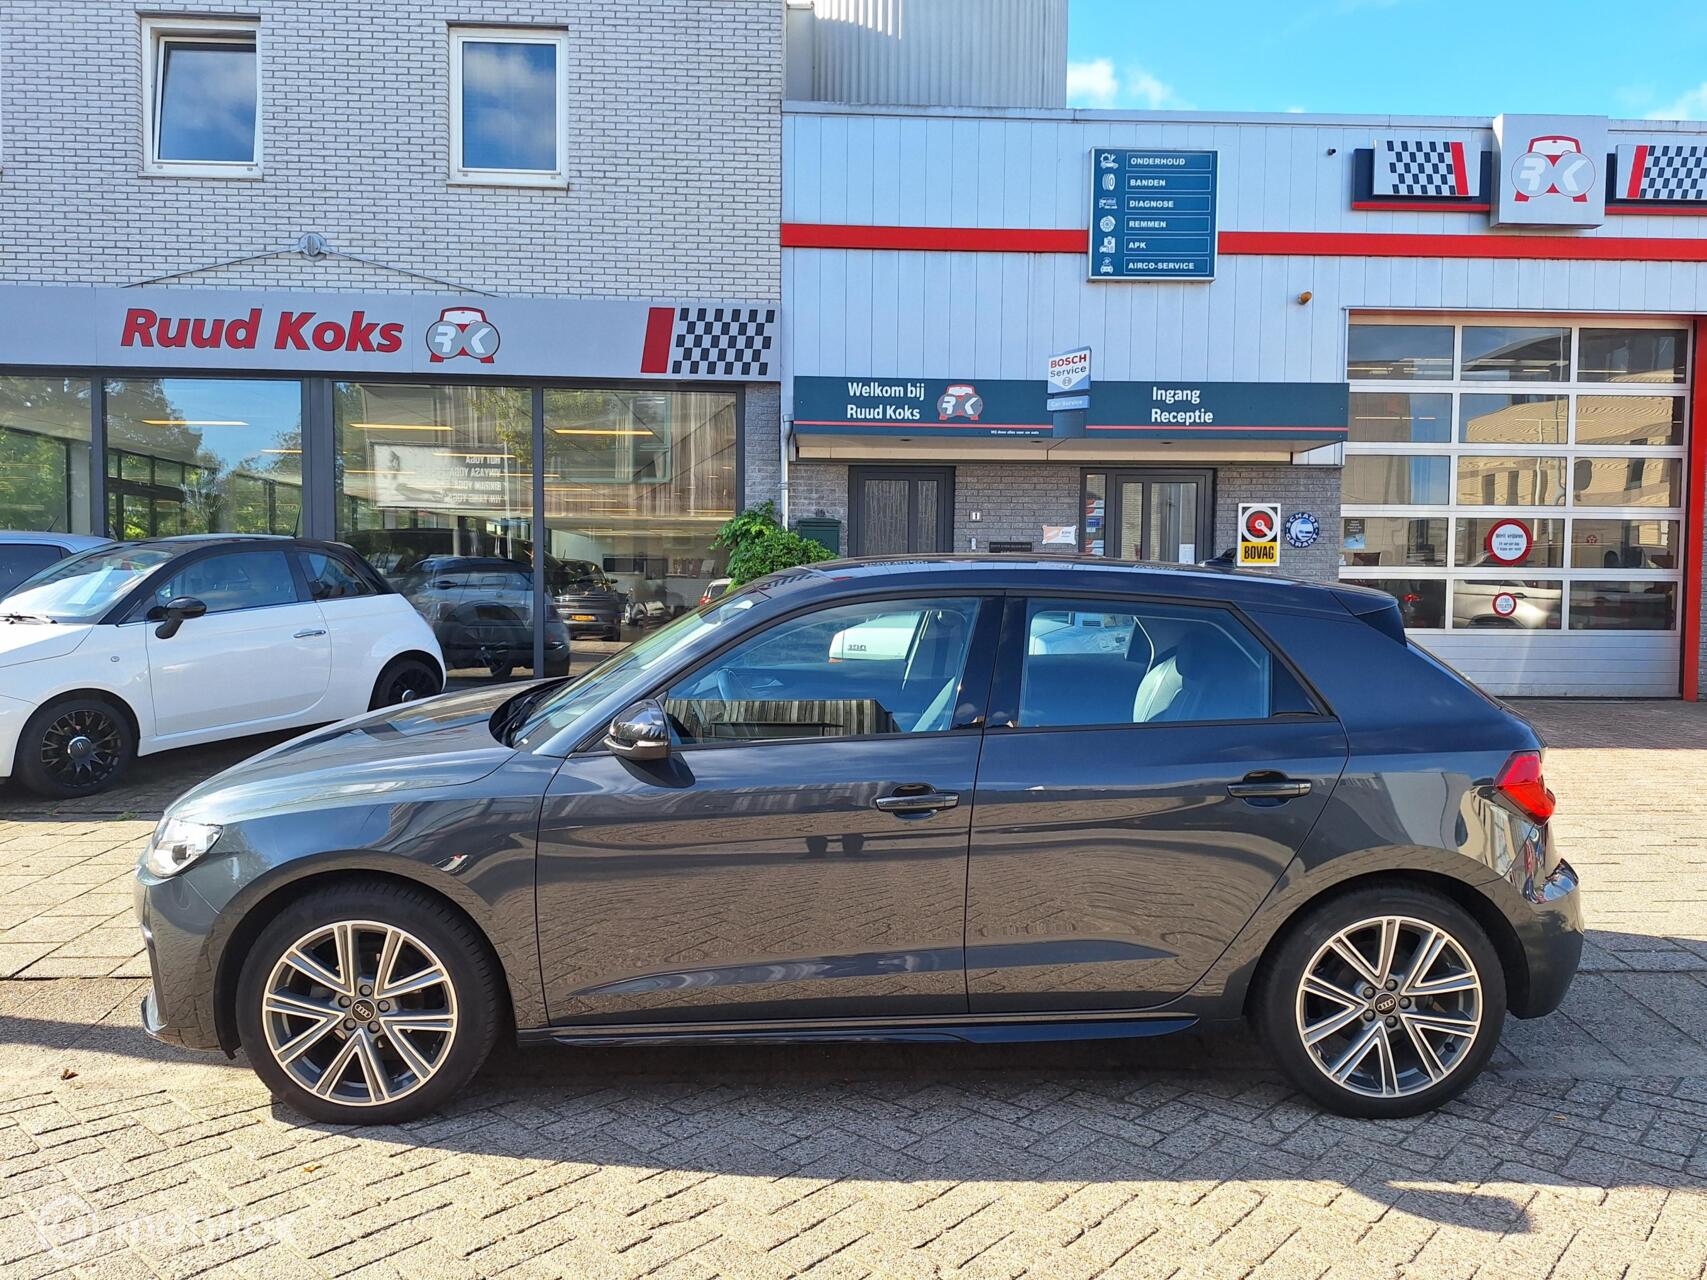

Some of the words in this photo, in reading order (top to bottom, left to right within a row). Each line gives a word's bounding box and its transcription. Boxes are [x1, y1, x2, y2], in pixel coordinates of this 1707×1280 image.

[1130, 157, 1186, 166] ONDERHOUD
[1129, 179, 1166, 187] BANDEN
[1129, 200, 1174, 208] DIAGNOSE
[1128, 220, 1167, 228] REMMEN
[1127, 262, 1195, 270] AIRCO-SERVICE
[120, 308, 263, 349] Ruud
[274, 310, 404, 353] Koks
[1050, 353, 1087, 369] BOSCH
[1050, 366, 1087, 378] Service
[847, 382, 904, 398] Welkom
[907, 382, 925, 401] bij
[1152, 386, 1201, 404] Ingang
[846, 404, 883, 419] Ruud
[886, 404, 921, 420] Koks
[1151, 408, 1214, 426] Receptie
[1285, 512, 1319, 528] SCHADE
[1243, 545, 1275, 560] BOVAG
